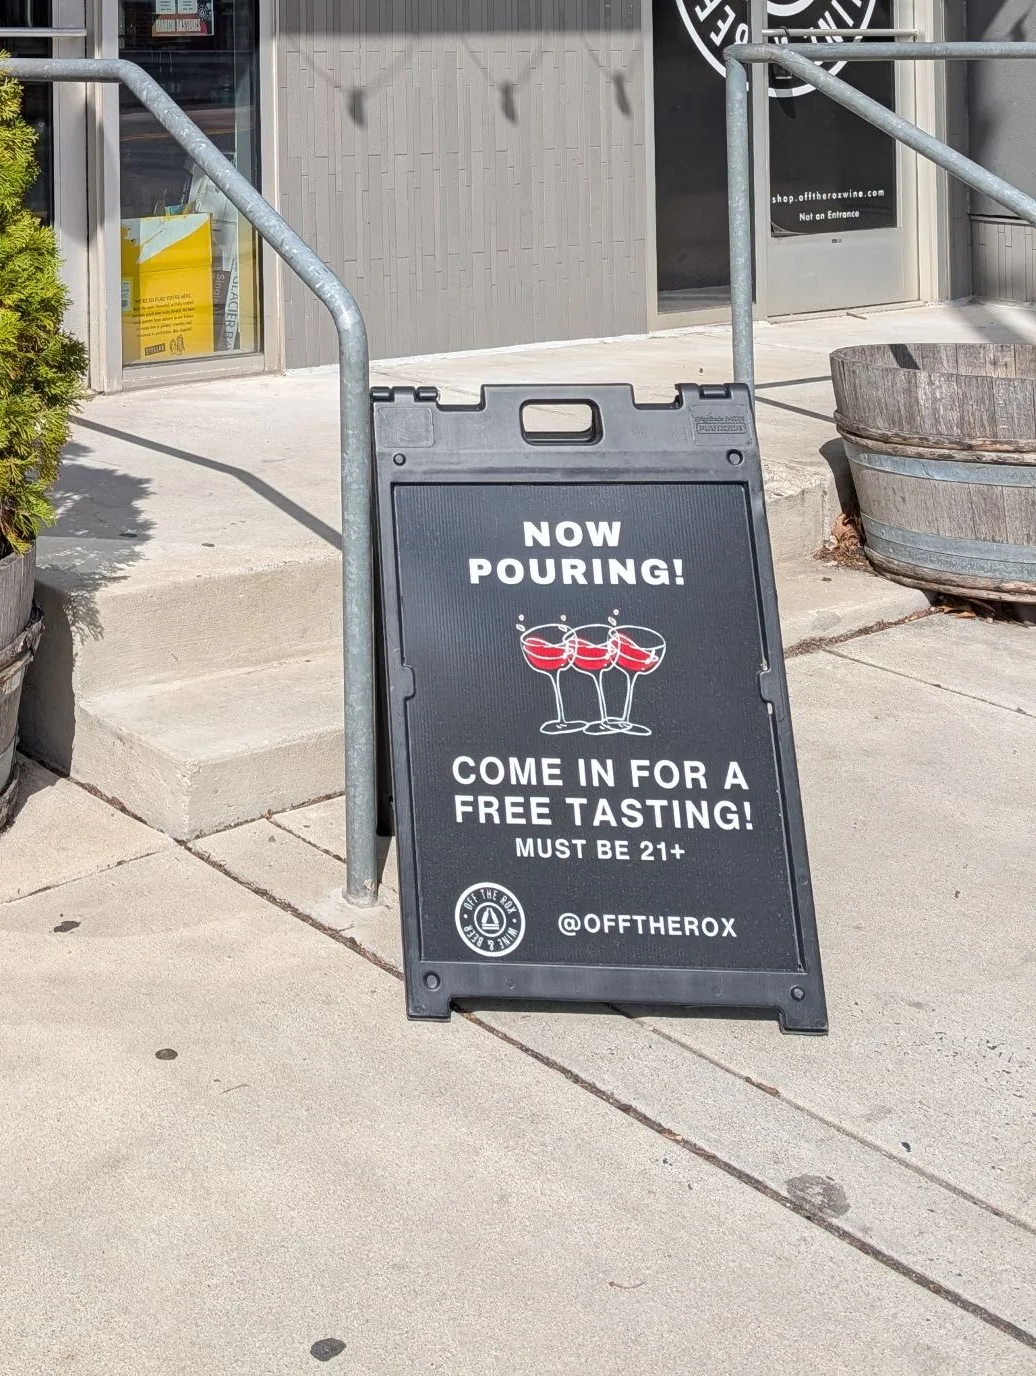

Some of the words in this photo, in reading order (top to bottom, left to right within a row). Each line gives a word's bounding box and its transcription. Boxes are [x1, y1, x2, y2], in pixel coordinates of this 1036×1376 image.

[771, 189, 885, 204] shop.offtheroxwine.com
[799, 212, 814, 222] Not
[815, 213, 825, 221] an
[827, 210, 860, 220] Entrance
[523, 520, 622, 548] NOW
[468, 557, 685, 586] POURING!
[453, 756, 565, 787] COME
[578, 759, 616, 789] IN
[631, 760, 709, 791] FOR
[724, 762, 750, 791] A
[455, 795, 553, 827] FREE
[565, 798, 754, 832] TASTING!
[516, 838, 588, 860] MUST
[597, 840, 631, 861] BE
[640, 841, 686, 863] 21+
[463, 892, 478, 911] OFF
[480, 888, 499, 901] THE
[499, 895, 517, 915] ROX
[463, 924, 484, 948] BEER
[557, 912, 737, 938] @OFFTHEROX
[487, 939, 494, 951] &
[497, 926, 518, 950] WINE
